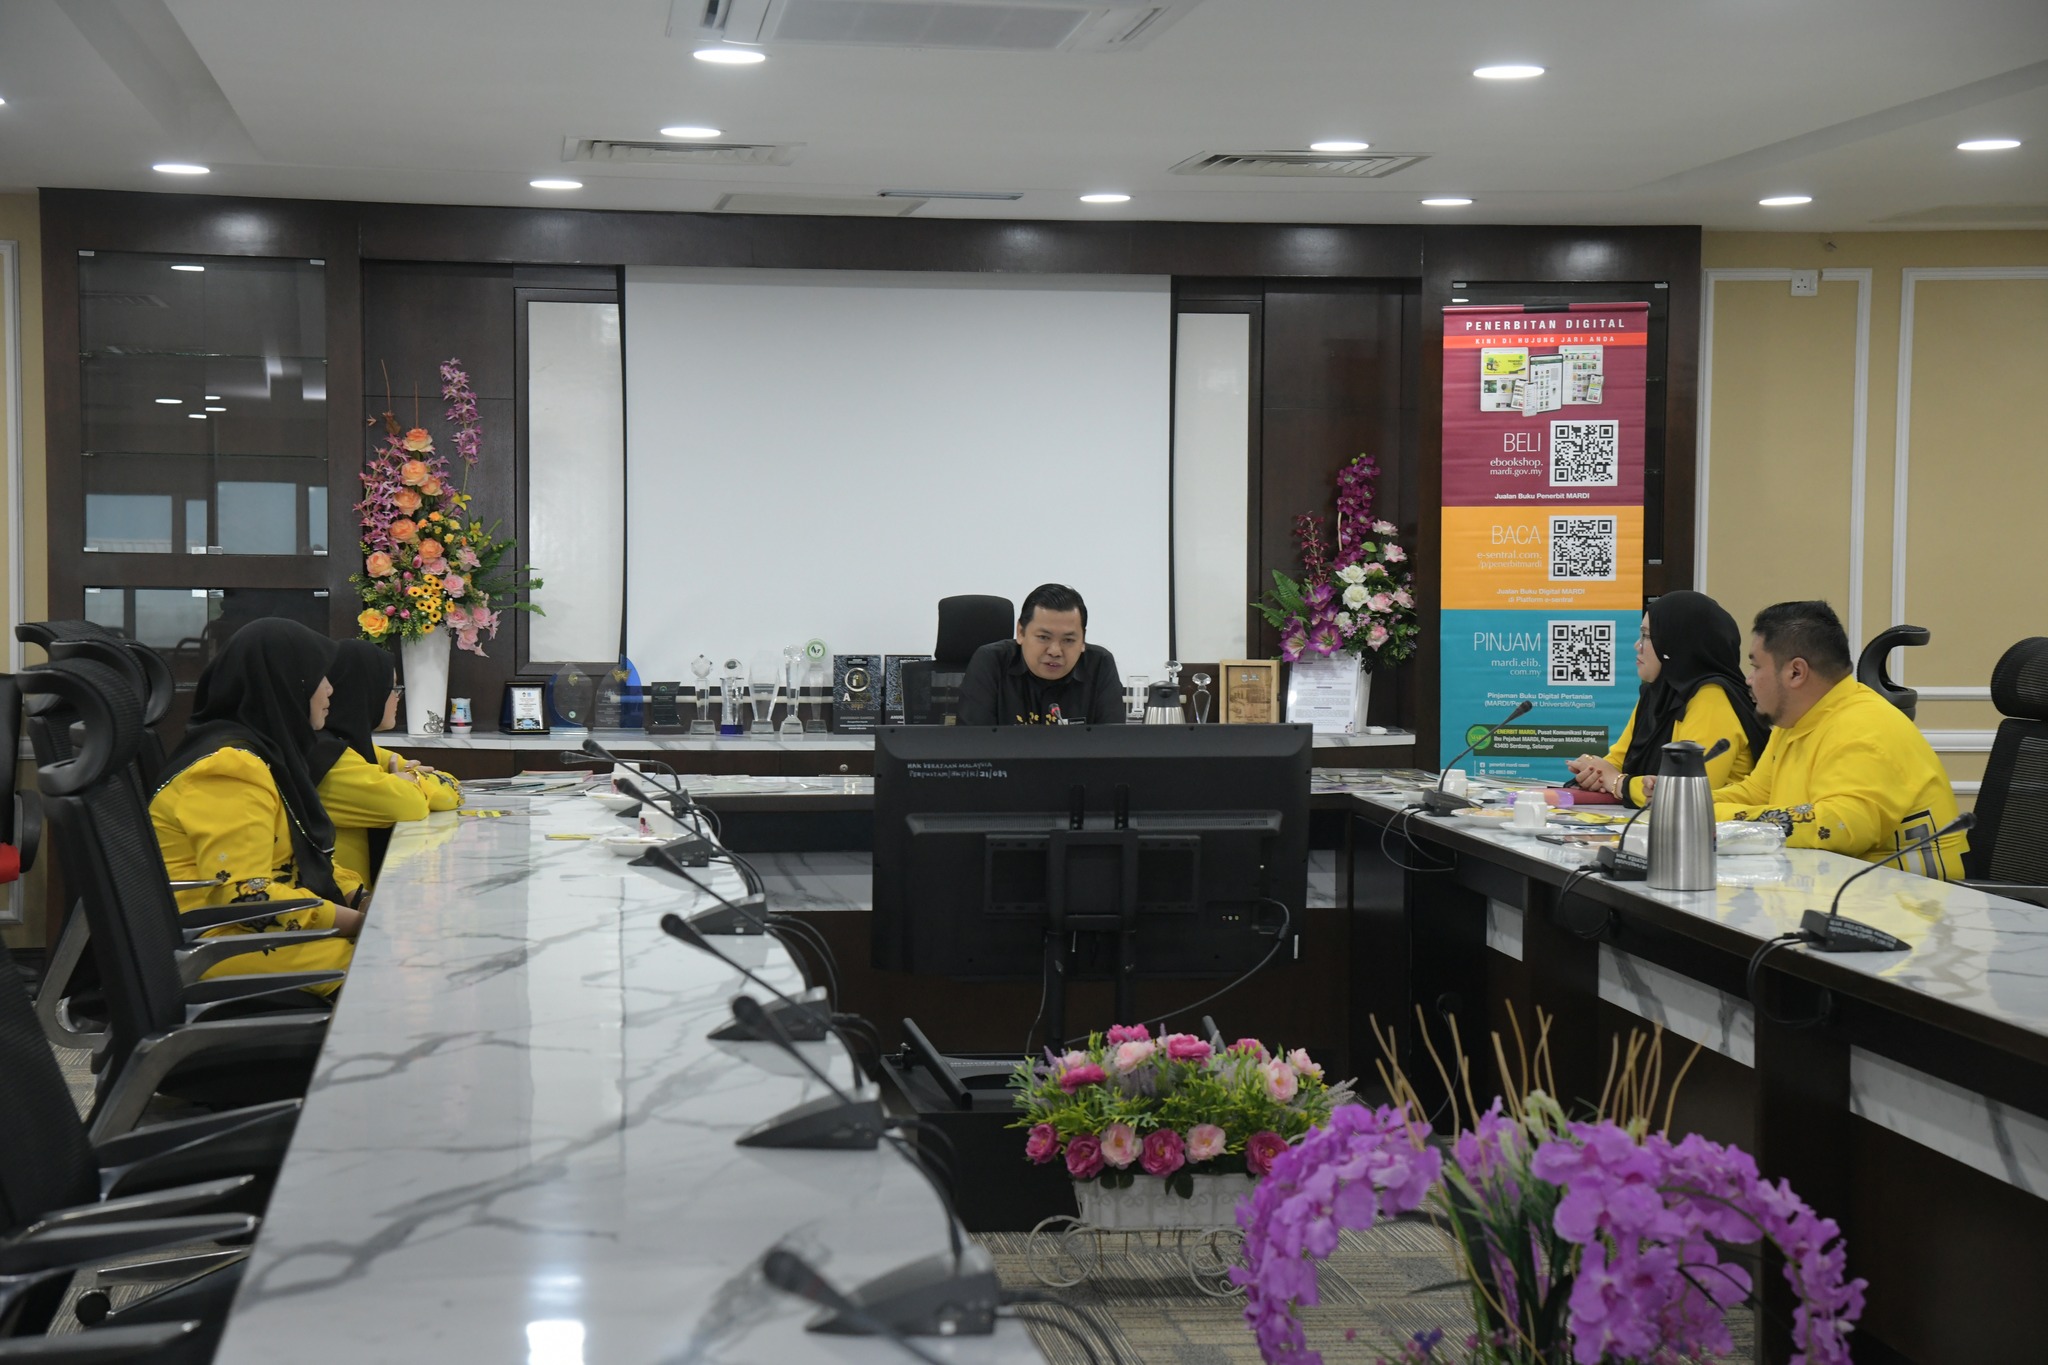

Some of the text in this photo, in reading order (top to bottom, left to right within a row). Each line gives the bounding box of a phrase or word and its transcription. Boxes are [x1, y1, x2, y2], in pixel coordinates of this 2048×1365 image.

[1466, 318, 1625, 331] PENERBITAN DIGITAL
[1503, 432, 1541, 452] BELI
[1490, 457, 1543, 468] ebookshop.
[1490, 467, 1542, 477] mardi.gov.my
[1491, 525, 1542, 545] BACA
[1478, 560, 1542, 569] /p/penerbitmardi
[1538, 588, 1560, 596] Digital
[1473, 632, 1541, 652] PINJAM
[1491, 658, 1541, 667] mardi.elib.
[1510, 669, 1542, 677] com.my
[1487, 692, 1518, 700] Pinjaman
